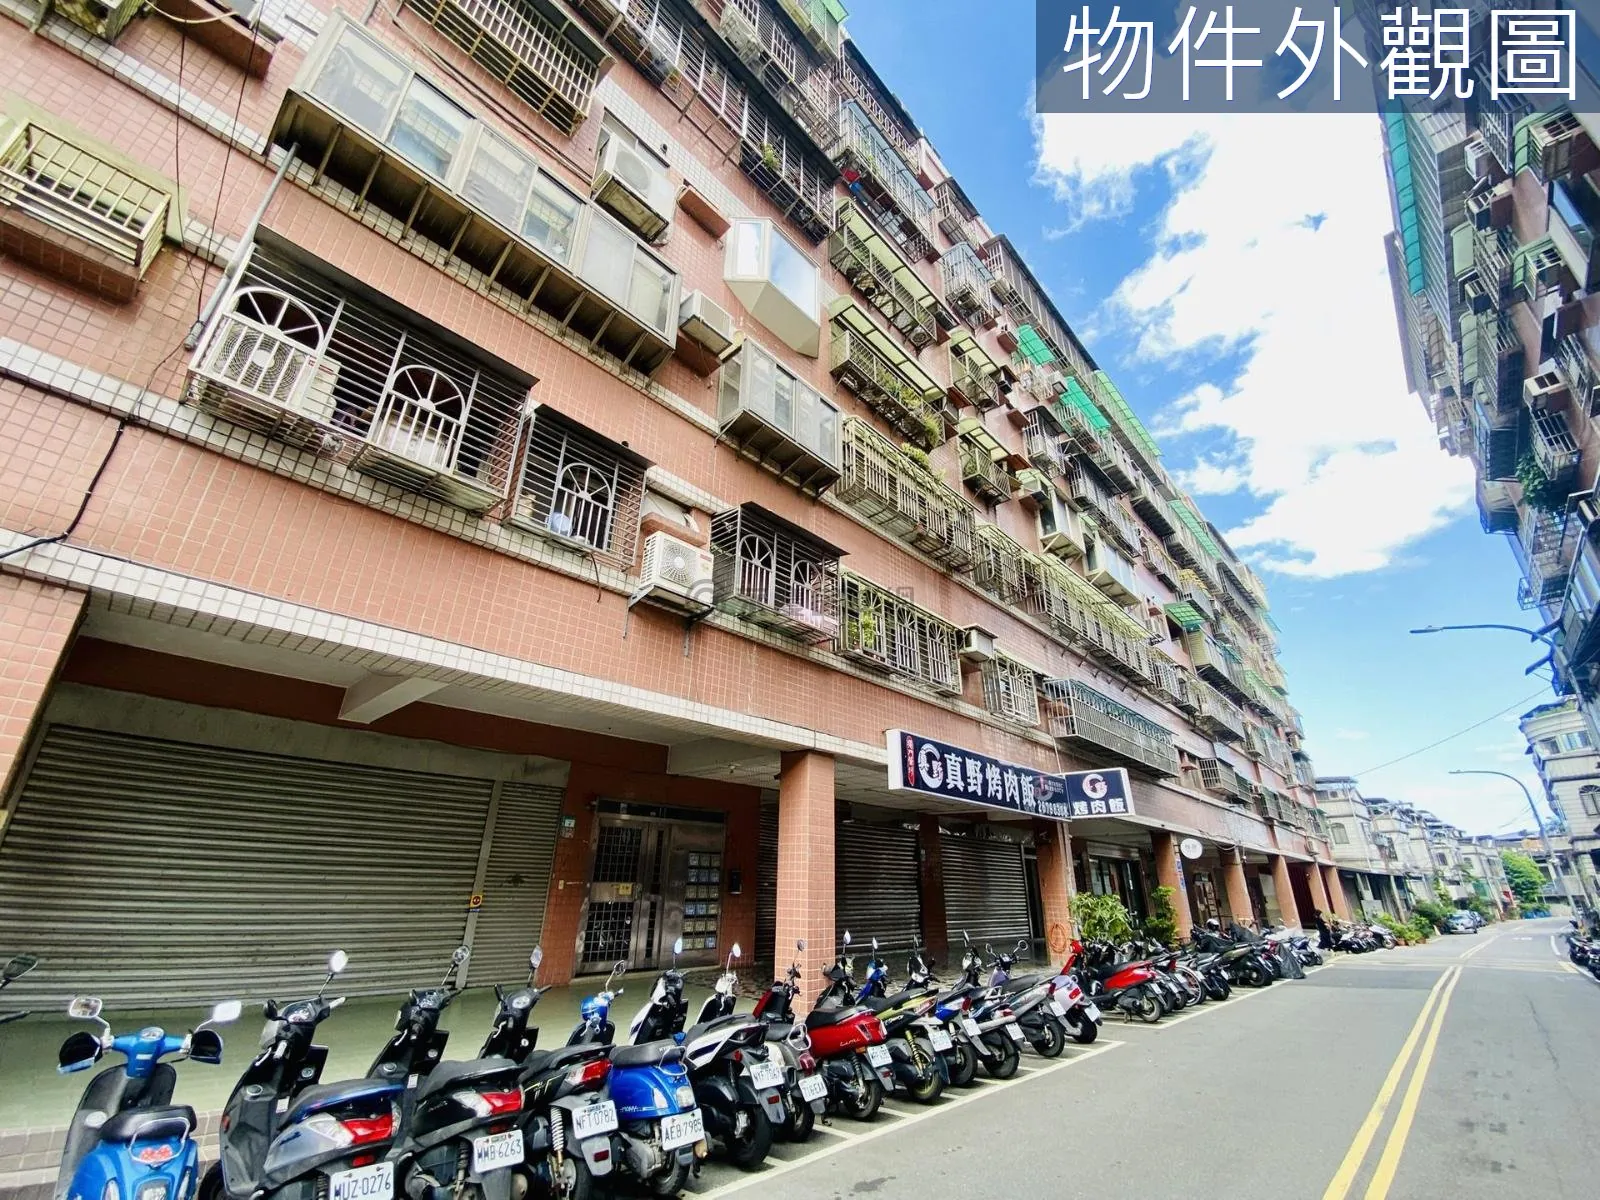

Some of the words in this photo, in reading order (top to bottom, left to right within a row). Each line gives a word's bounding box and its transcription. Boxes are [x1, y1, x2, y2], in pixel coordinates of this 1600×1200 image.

[944, 753, 1036, 807] 真野烤肉飯
